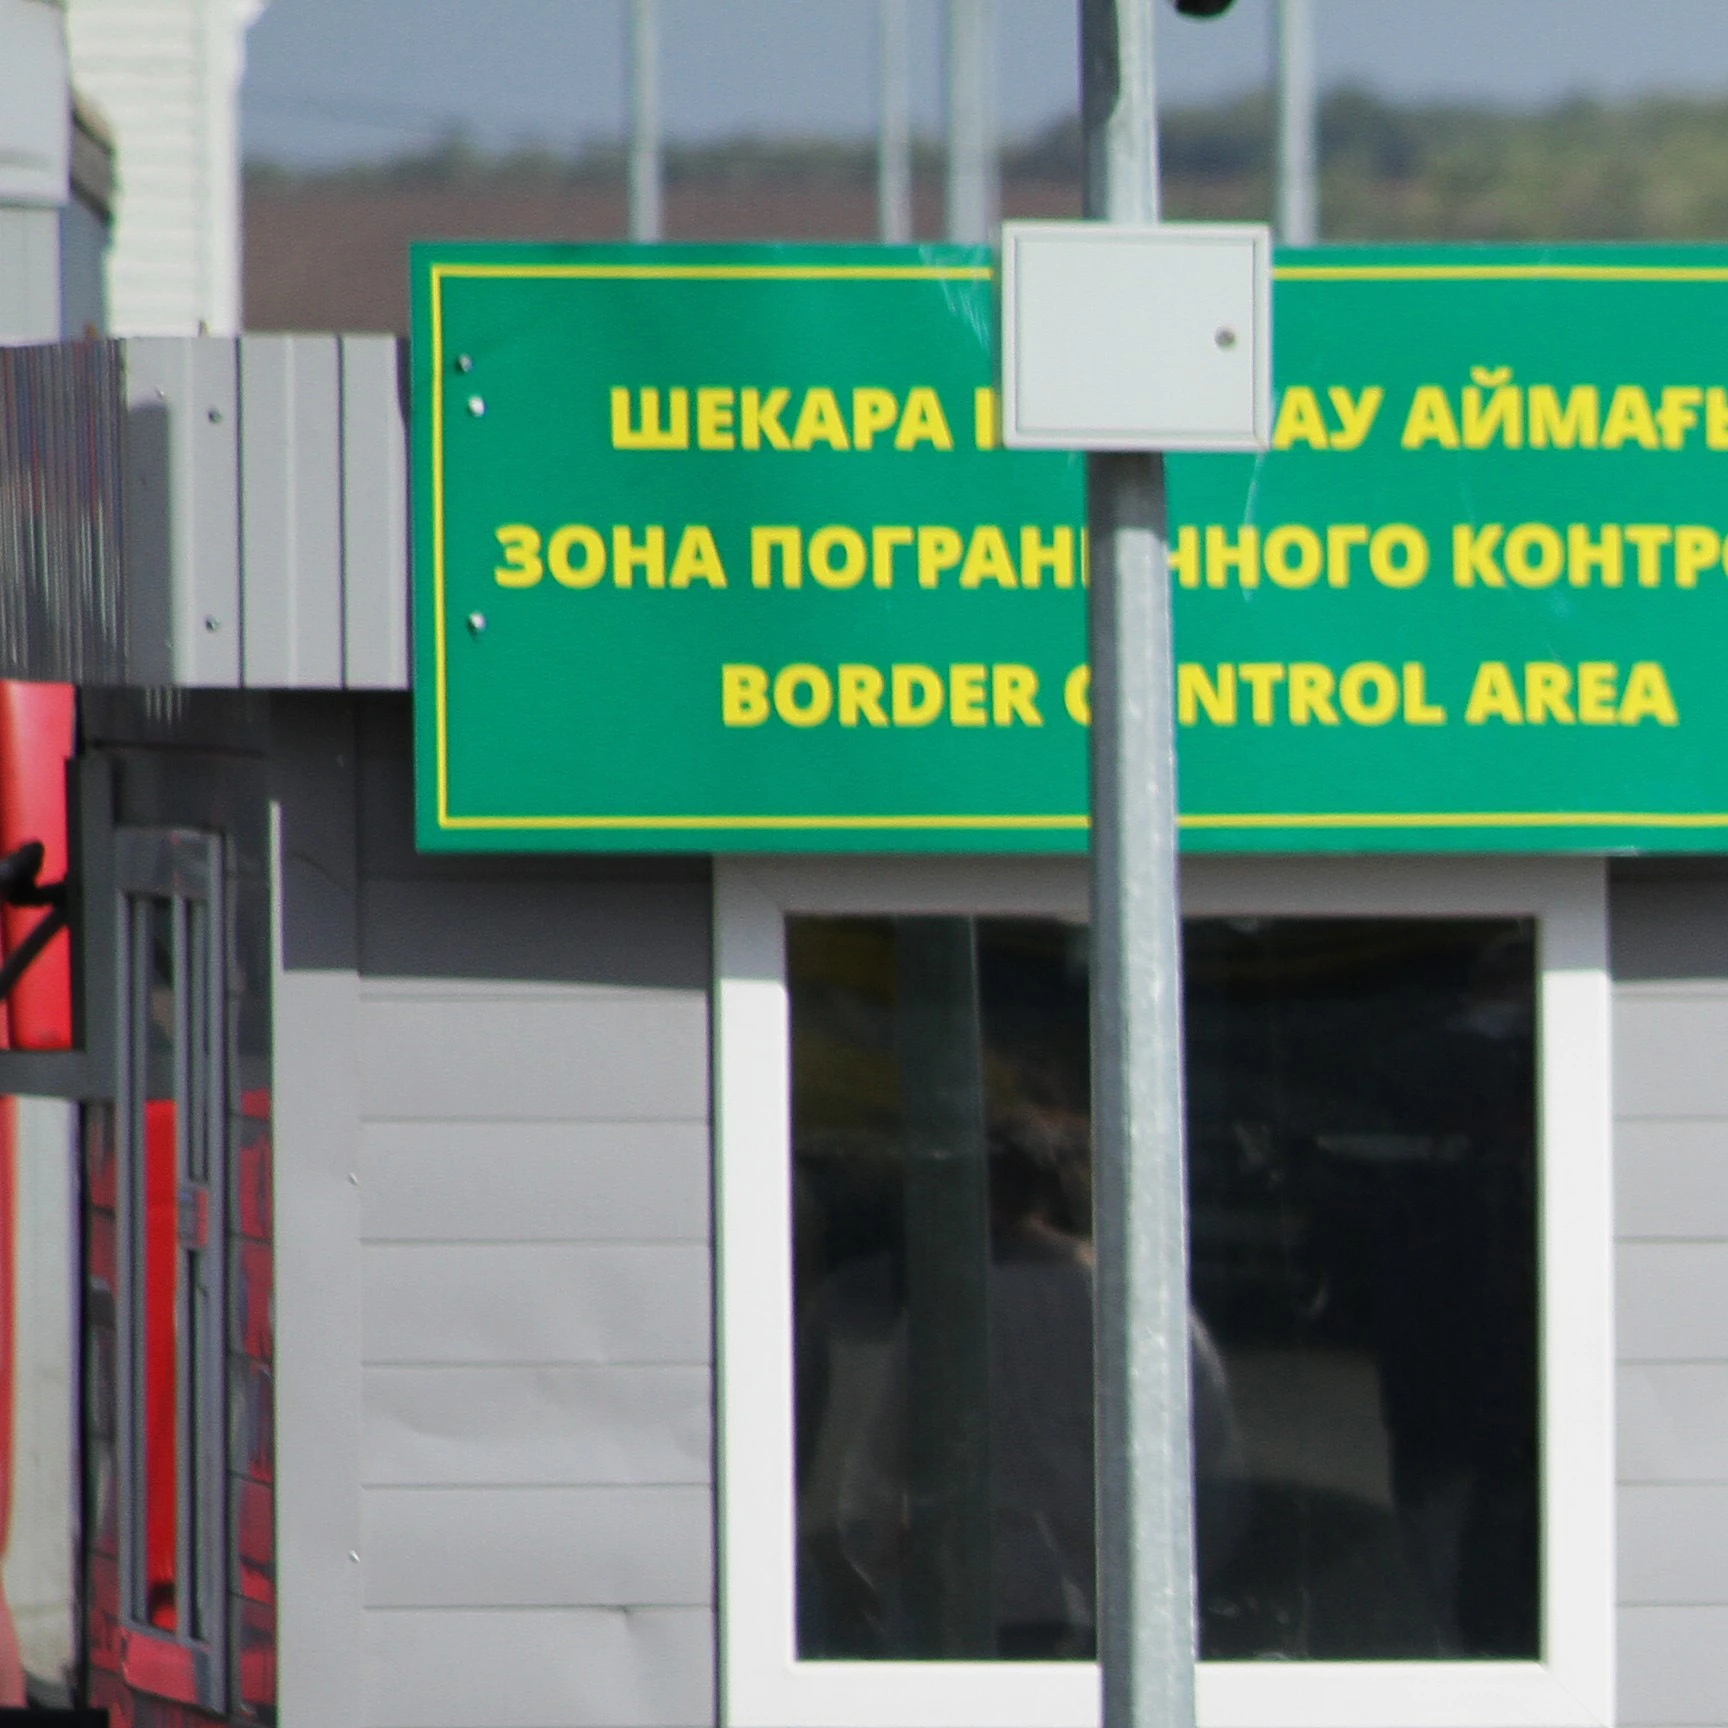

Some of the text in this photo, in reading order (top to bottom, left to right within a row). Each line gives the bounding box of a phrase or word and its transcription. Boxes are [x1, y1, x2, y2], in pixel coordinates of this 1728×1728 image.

[610, 386, 954, 451] ШЕКАРА
[494, 524, 728, 589] ЗОНА
[721, 661, 1679, 728] BORDER CNTROL AREA
